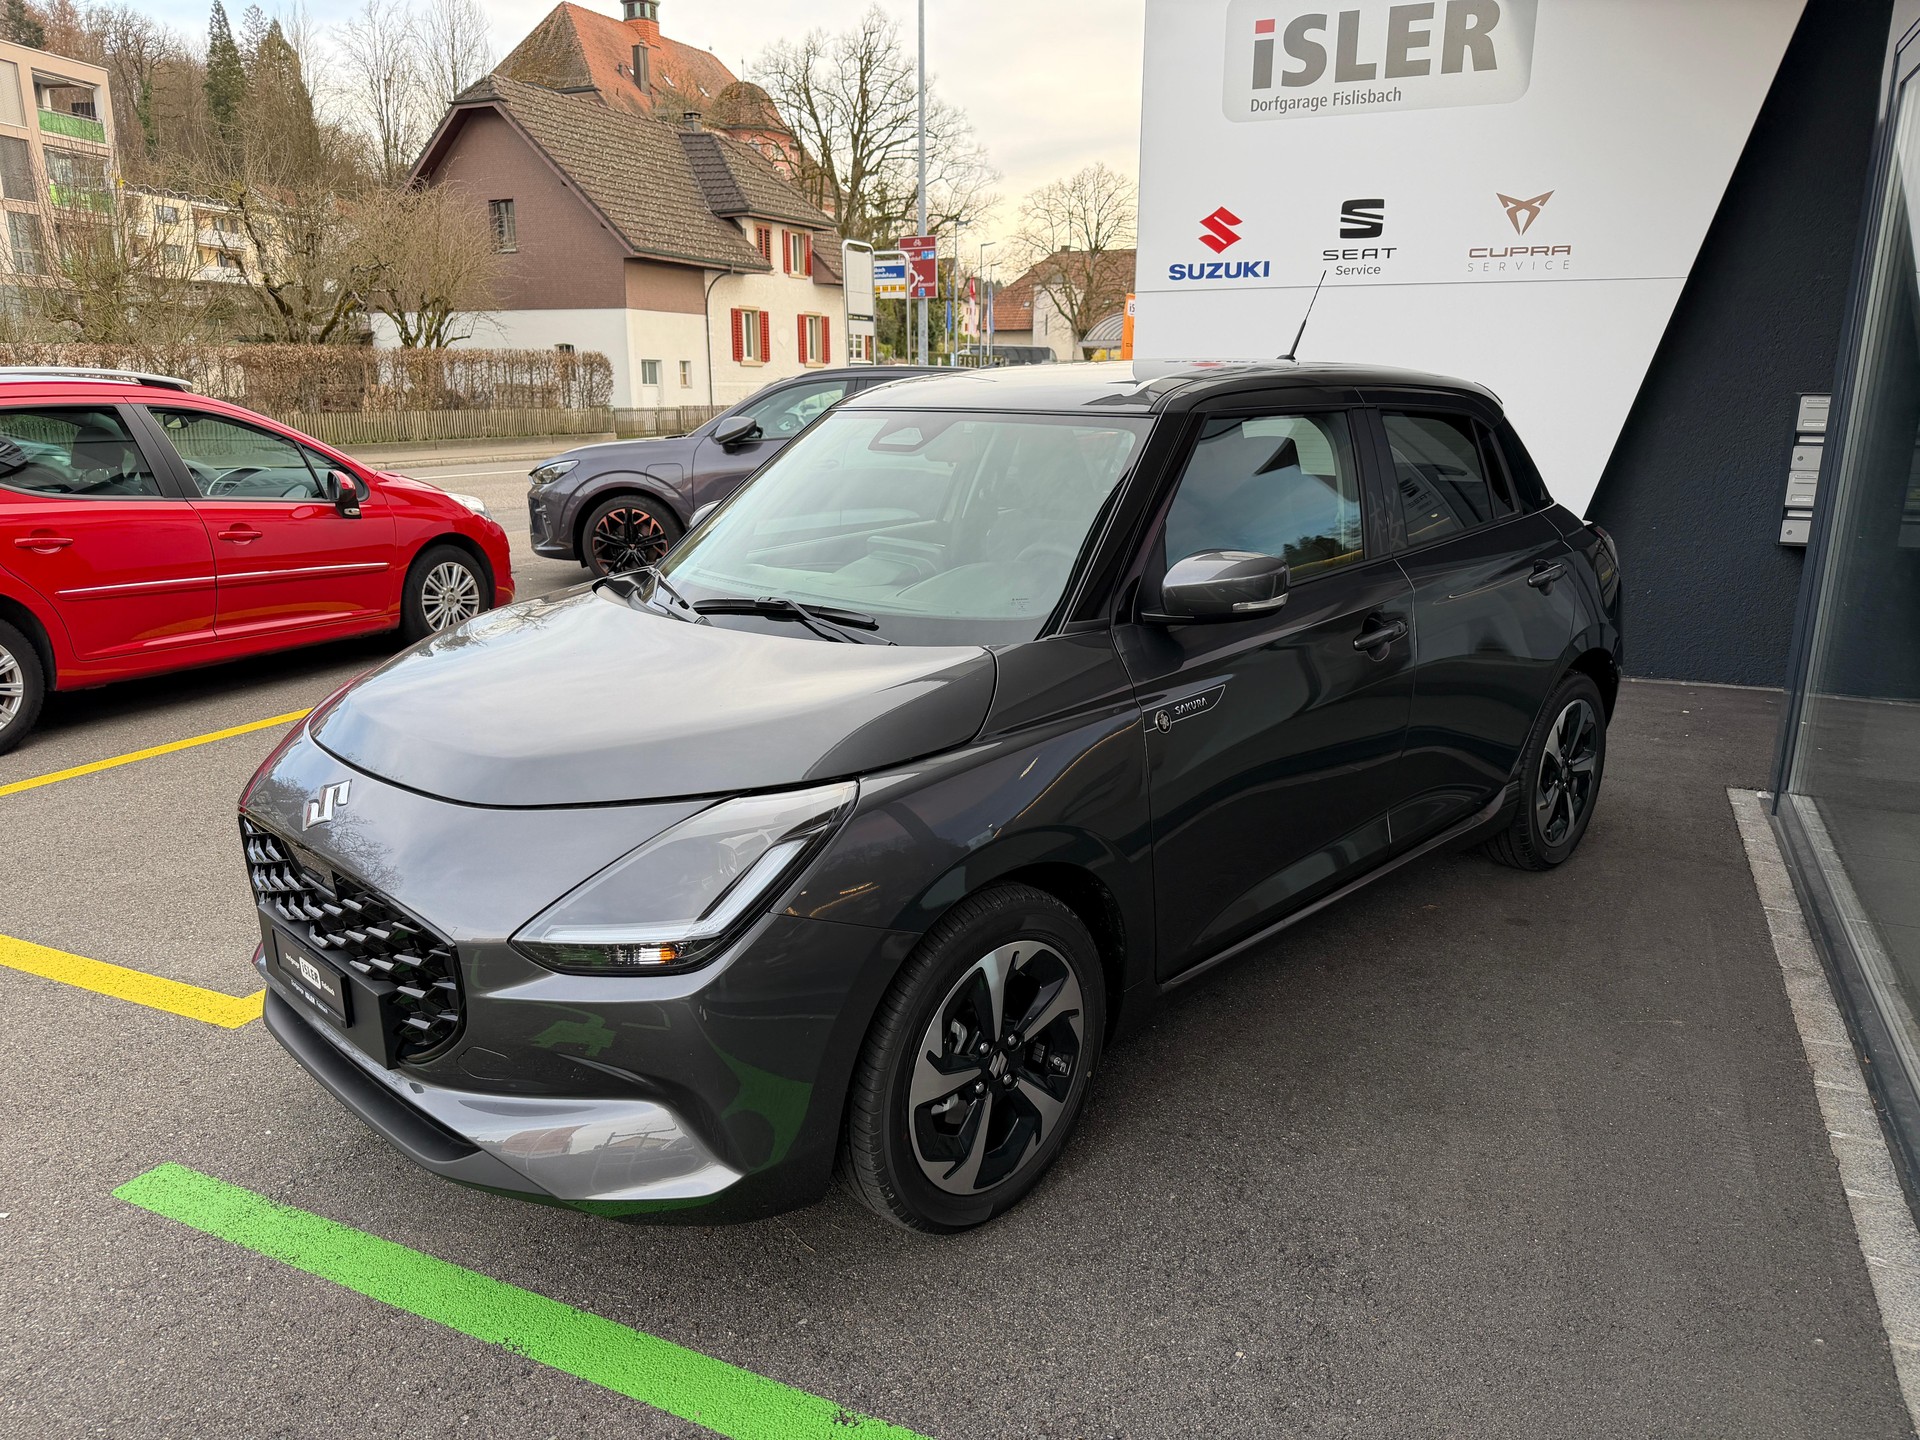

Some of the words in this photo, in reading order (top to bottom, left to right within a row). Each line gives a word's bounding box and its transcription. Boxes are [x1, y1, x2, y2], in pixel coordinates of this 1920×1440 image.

[1252, 0, 1501, 90] iSLER
[1250, 95, 1328, 114] Dorfgarage
[1332, 87, 1402, 106] Fislisbach
[1322, 247, 1398, 261] SEAT
[1469, 245, 1572, 258] CUPRA
[1168, 260, 1271, 281] SUZUKI
[1335, 263, 1382, 276] Service
[1467, 260, 1570, 272] SERVICE
[1174, 697, 1208, 715] SAKURA
